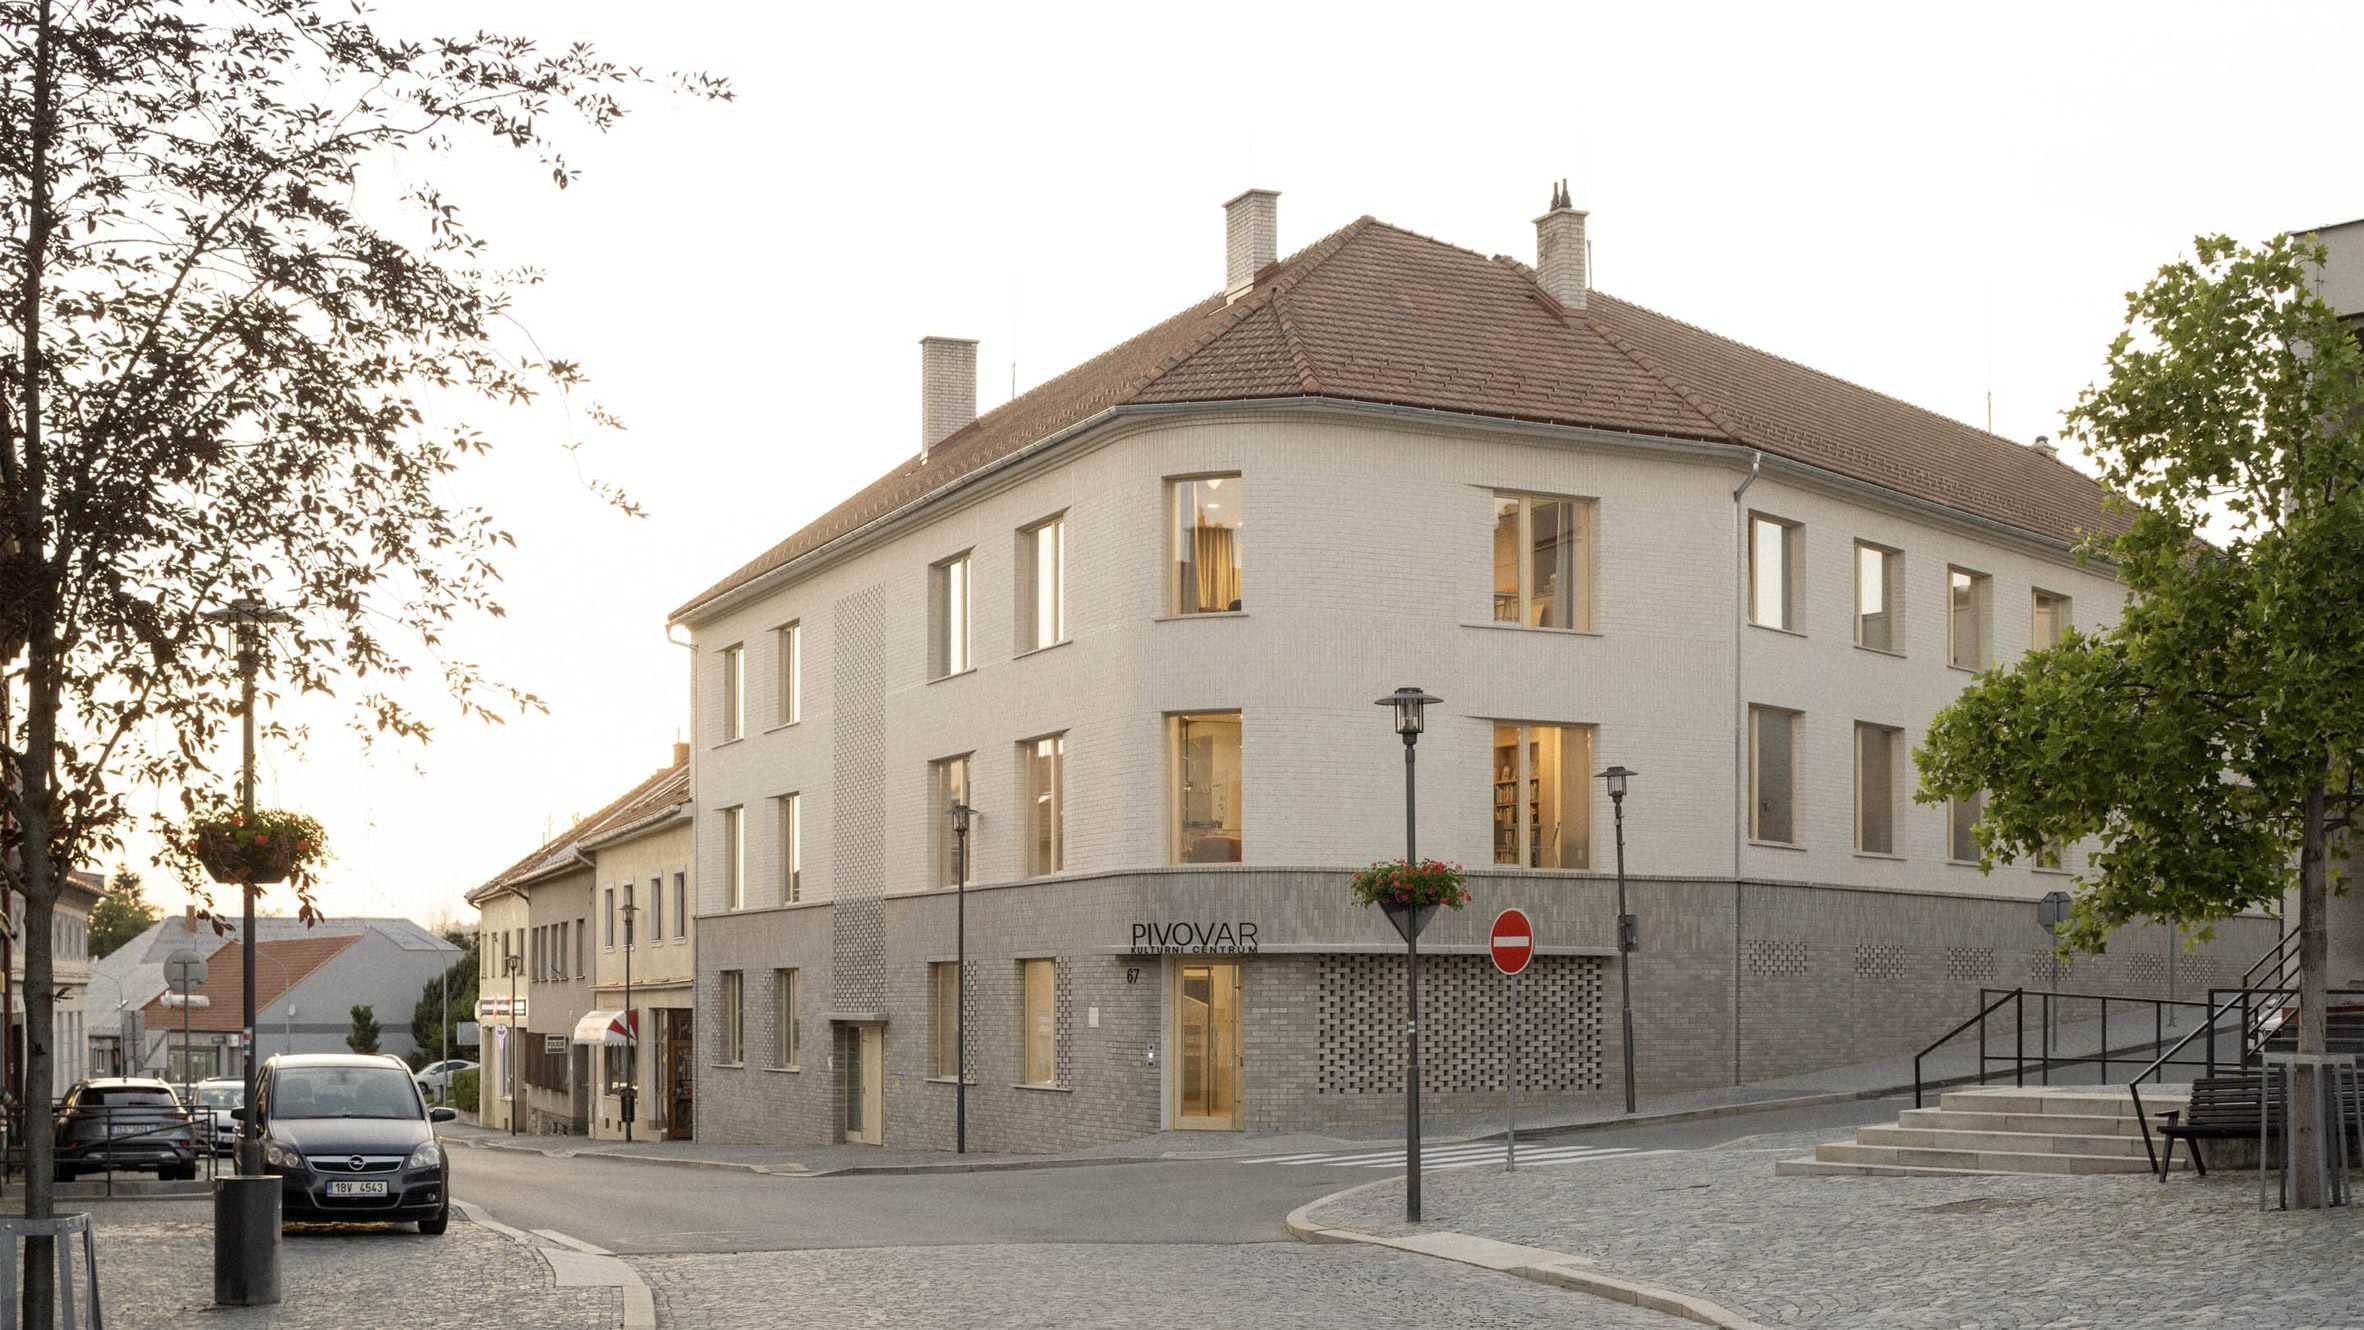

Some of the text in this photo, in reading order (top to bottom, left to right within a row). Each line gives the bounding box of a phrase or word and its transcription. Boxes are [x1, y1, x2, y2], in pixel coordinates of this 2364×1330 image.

[1132, 922, 1258, 946] PIVOVAR
[1192, 945, 1258, 954] CENTRUM
[1126, 968, 1140, 984] 67
[335, 1183, 383, 1193] 1BV 4543
